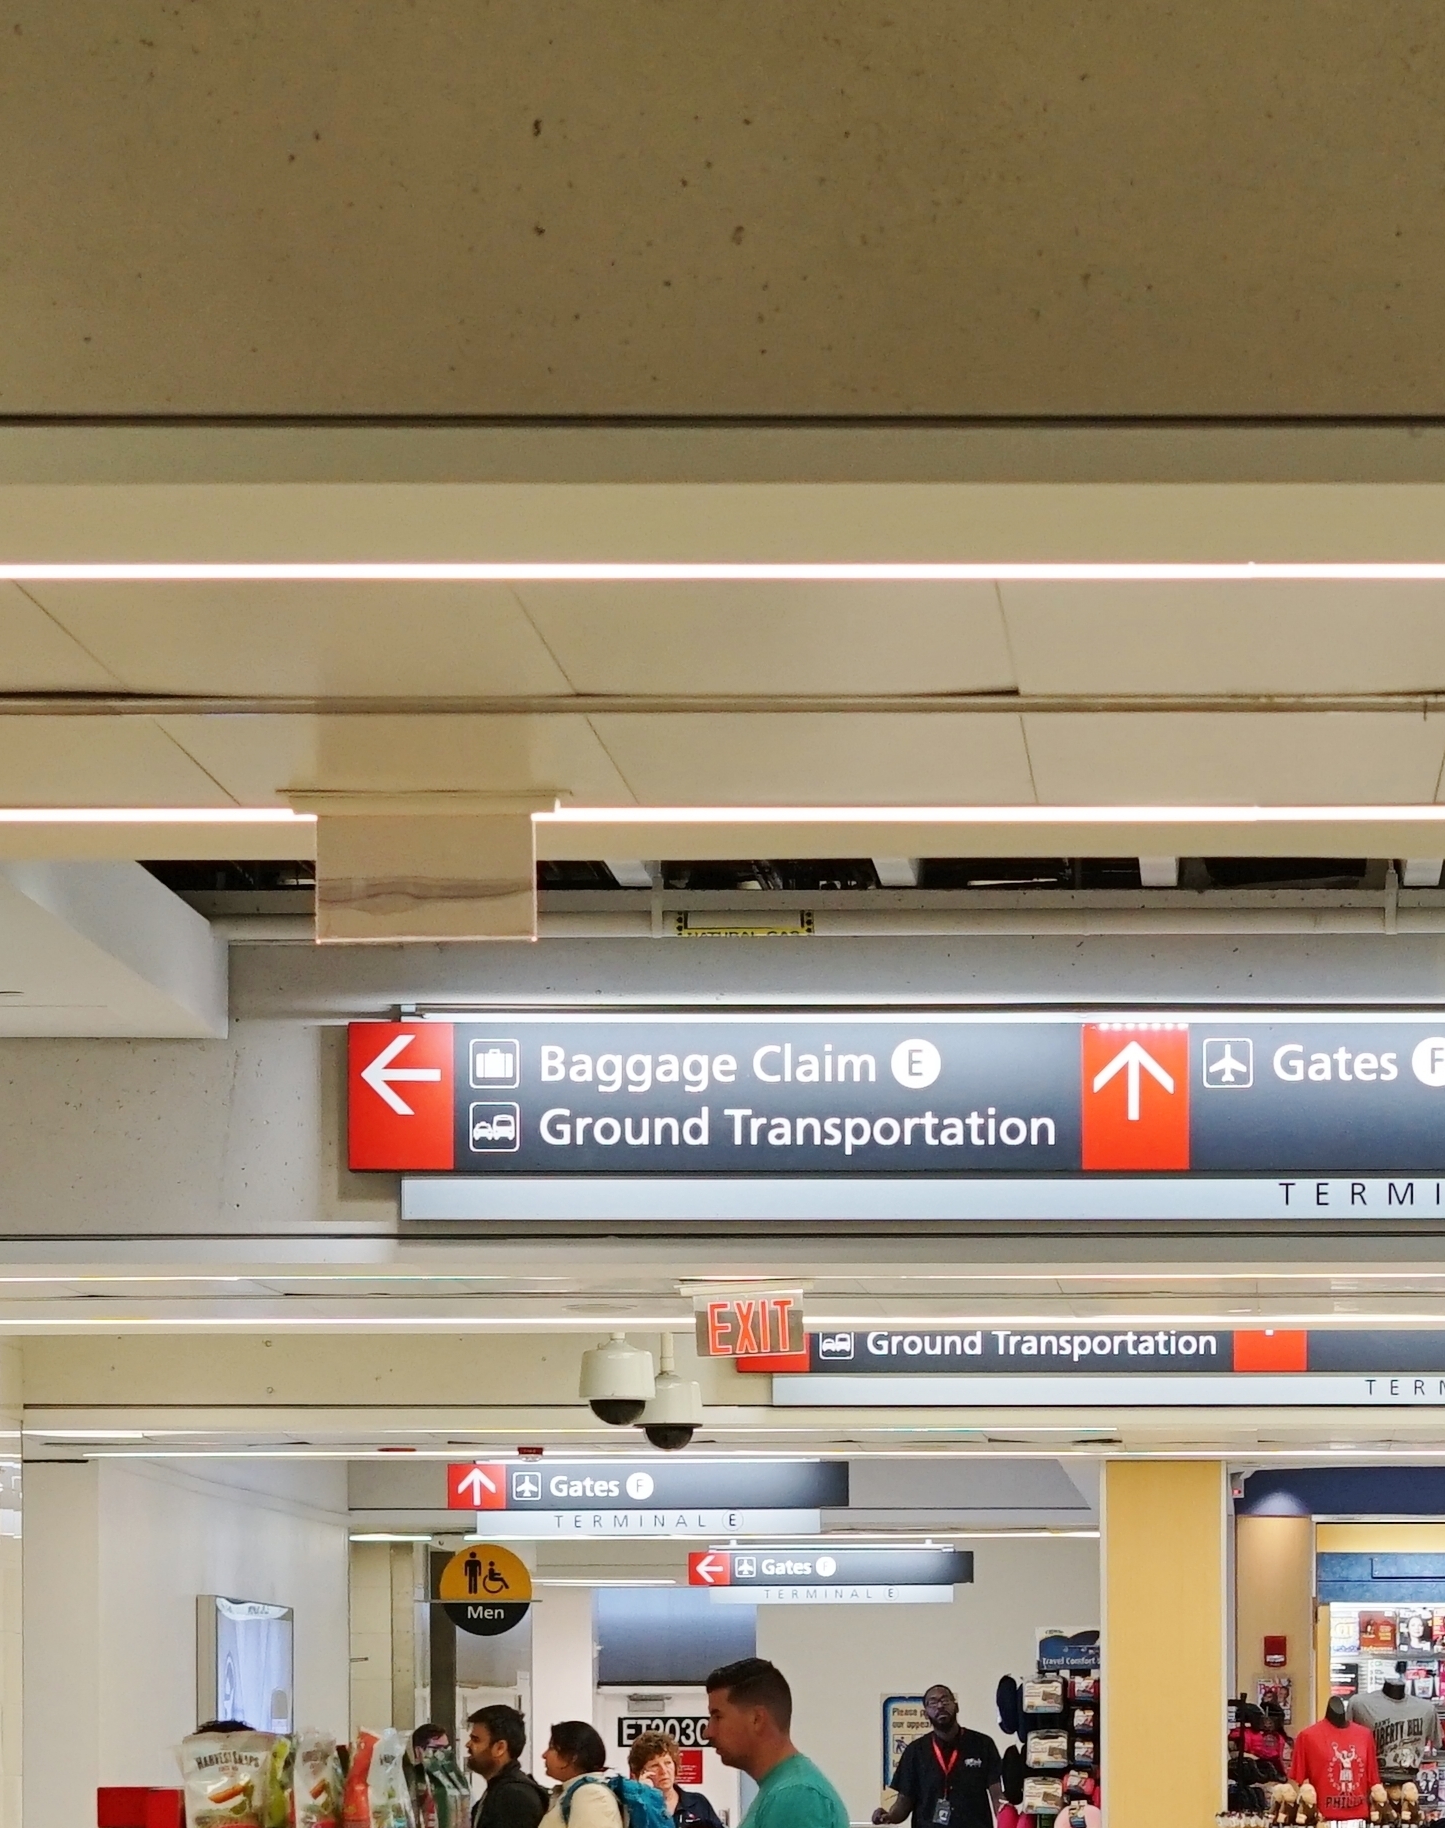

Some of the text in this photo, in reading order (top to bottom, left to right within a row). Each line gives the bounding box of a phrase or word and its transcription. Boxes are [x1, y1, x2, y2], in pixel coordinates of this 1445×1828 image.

[539, 1045, 737, 1092] Baggage
[753, 1043, 875, 1082] Claim
[1273, 1044, 1398, 1082] Gates
[539, 1106, 1055, 1155] Ground Transportation
[708, 1297, 795, 1355] EXIT
[866, 1331, 1217, 1362] Ground Transportation
[549, 1476, 620, 1497] Gates
[554, 1514, 706, 1528] TERMINAL
[762, 1558, 811, 1575] Gates
[764, 1588, 871, 1599] TERMINAL
[468, 1605, 504, 1619] Men
[892, 1708, 917, 1716] Please
